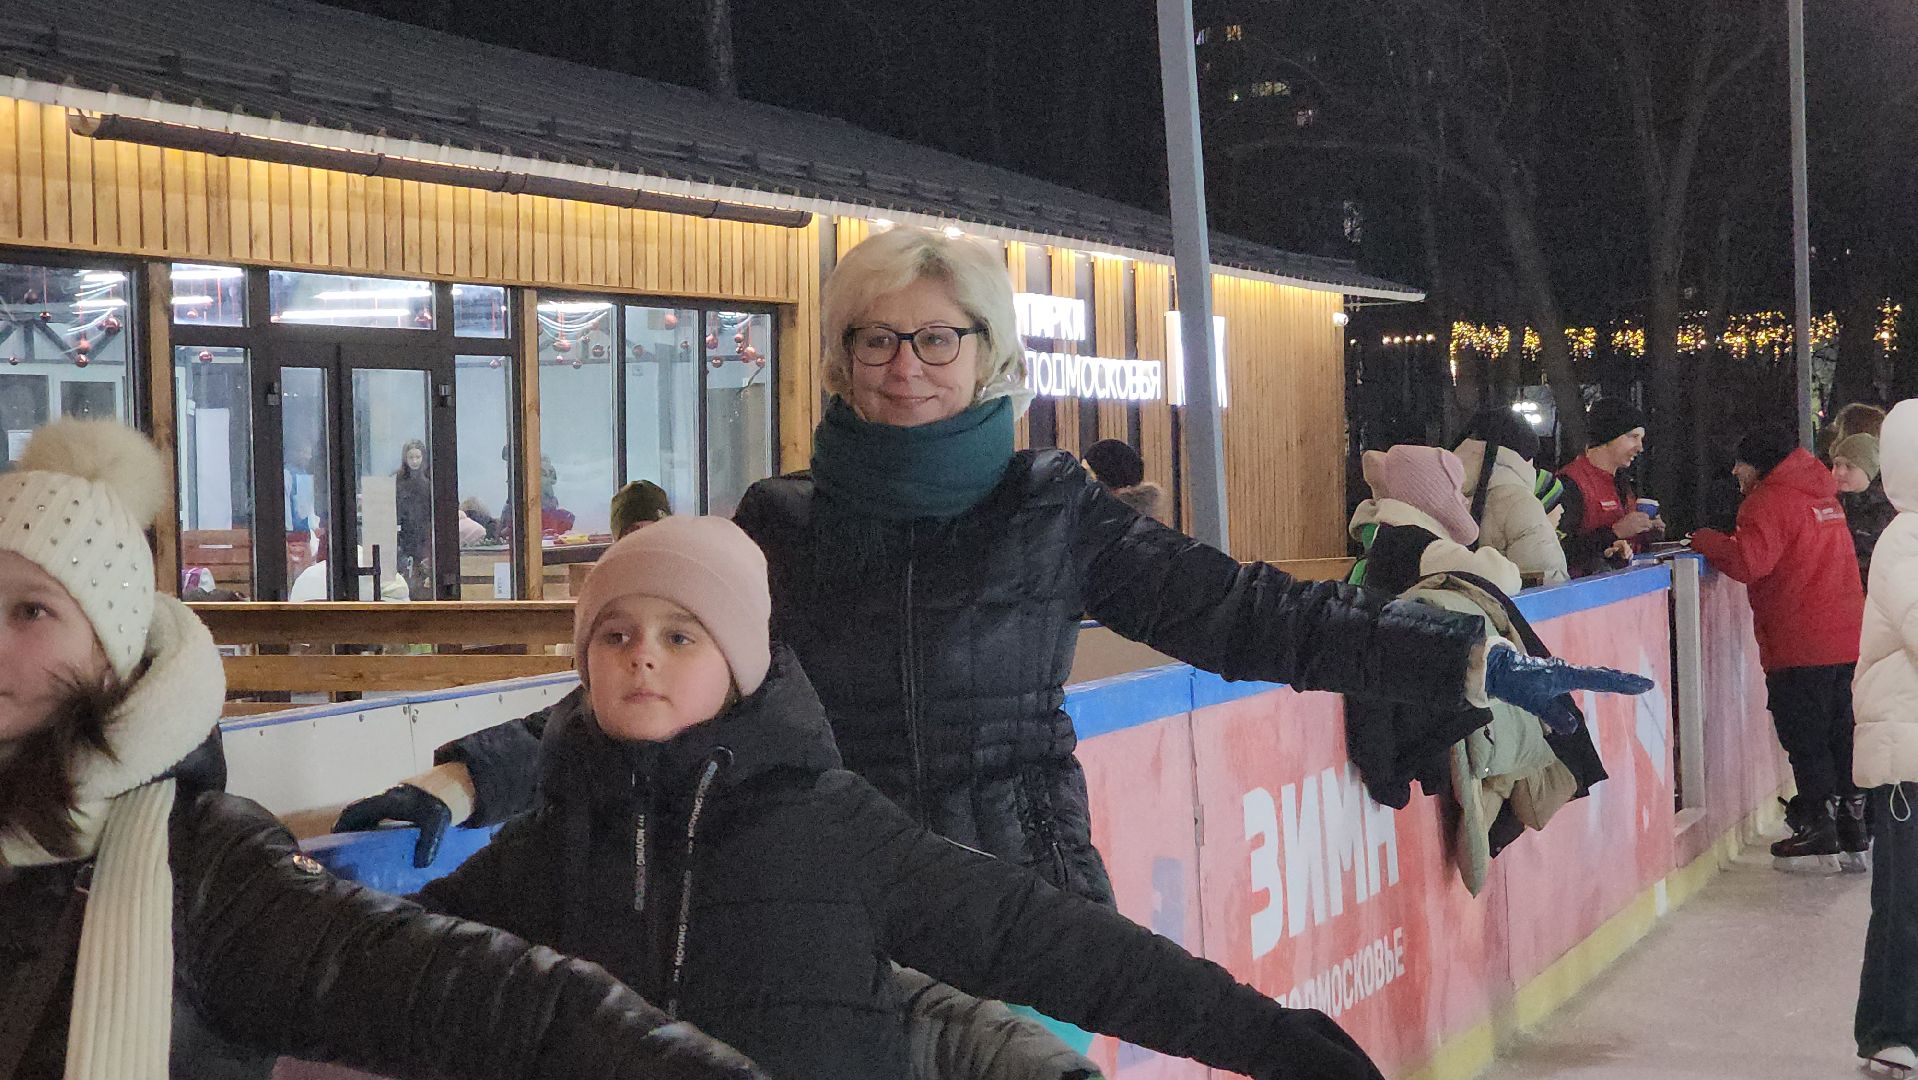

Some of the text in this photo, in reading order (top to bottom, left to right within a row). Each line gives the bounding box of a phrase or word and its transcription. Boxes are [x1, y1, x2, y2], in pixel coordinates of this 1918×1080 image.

[1024, 350, 1162, 400] ПОДМОСКОВЬЯ
[635, 828, 646, 866] MOVING
[675, 923, 688, 965] MOVING
[1274, 926, 1405, 1018] ДМОСКОВЬЕ
